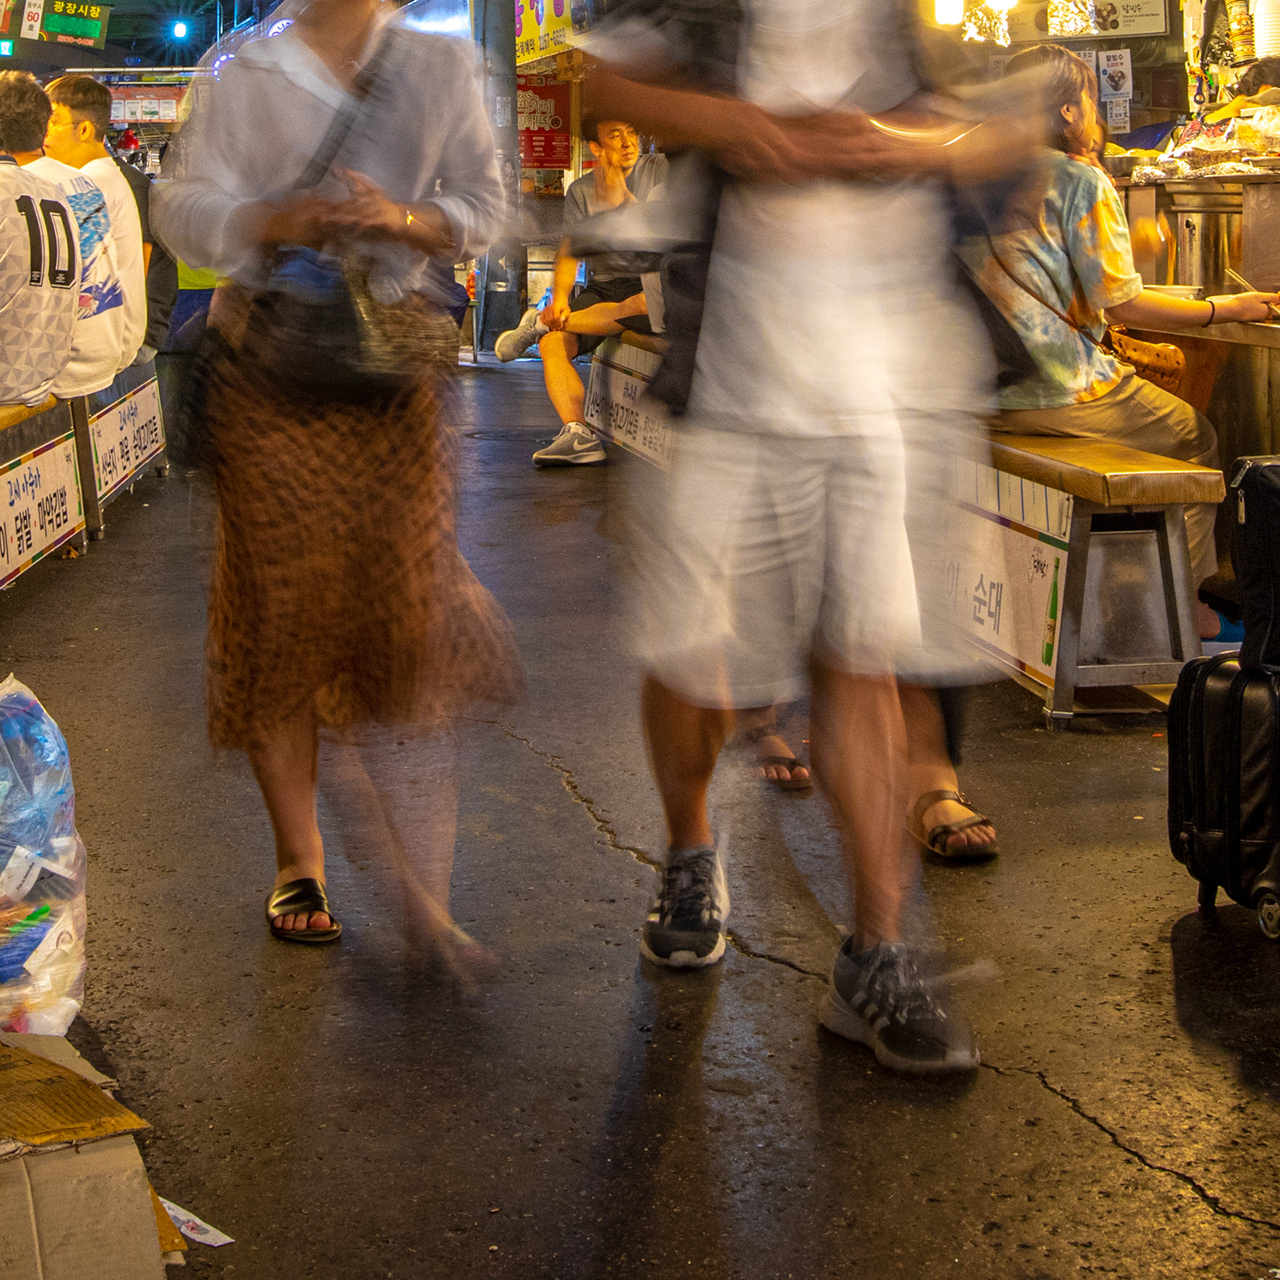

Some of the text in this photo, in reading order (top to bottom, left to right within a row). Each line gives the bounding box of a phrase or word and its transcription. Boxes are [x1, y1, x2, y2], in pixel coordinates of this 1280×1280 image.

[26, 11, 40, 23] 60
[53, 0, 101, 18] 광장시장
[16, 195, 77, 288] 10
[7, 466, 41, 507] 고씨 아줌마
[14, 507, 33, 556] 닭발
[37, 485, 68, 537] 마약김밥
[972, 573, 1003, 635] 순대
